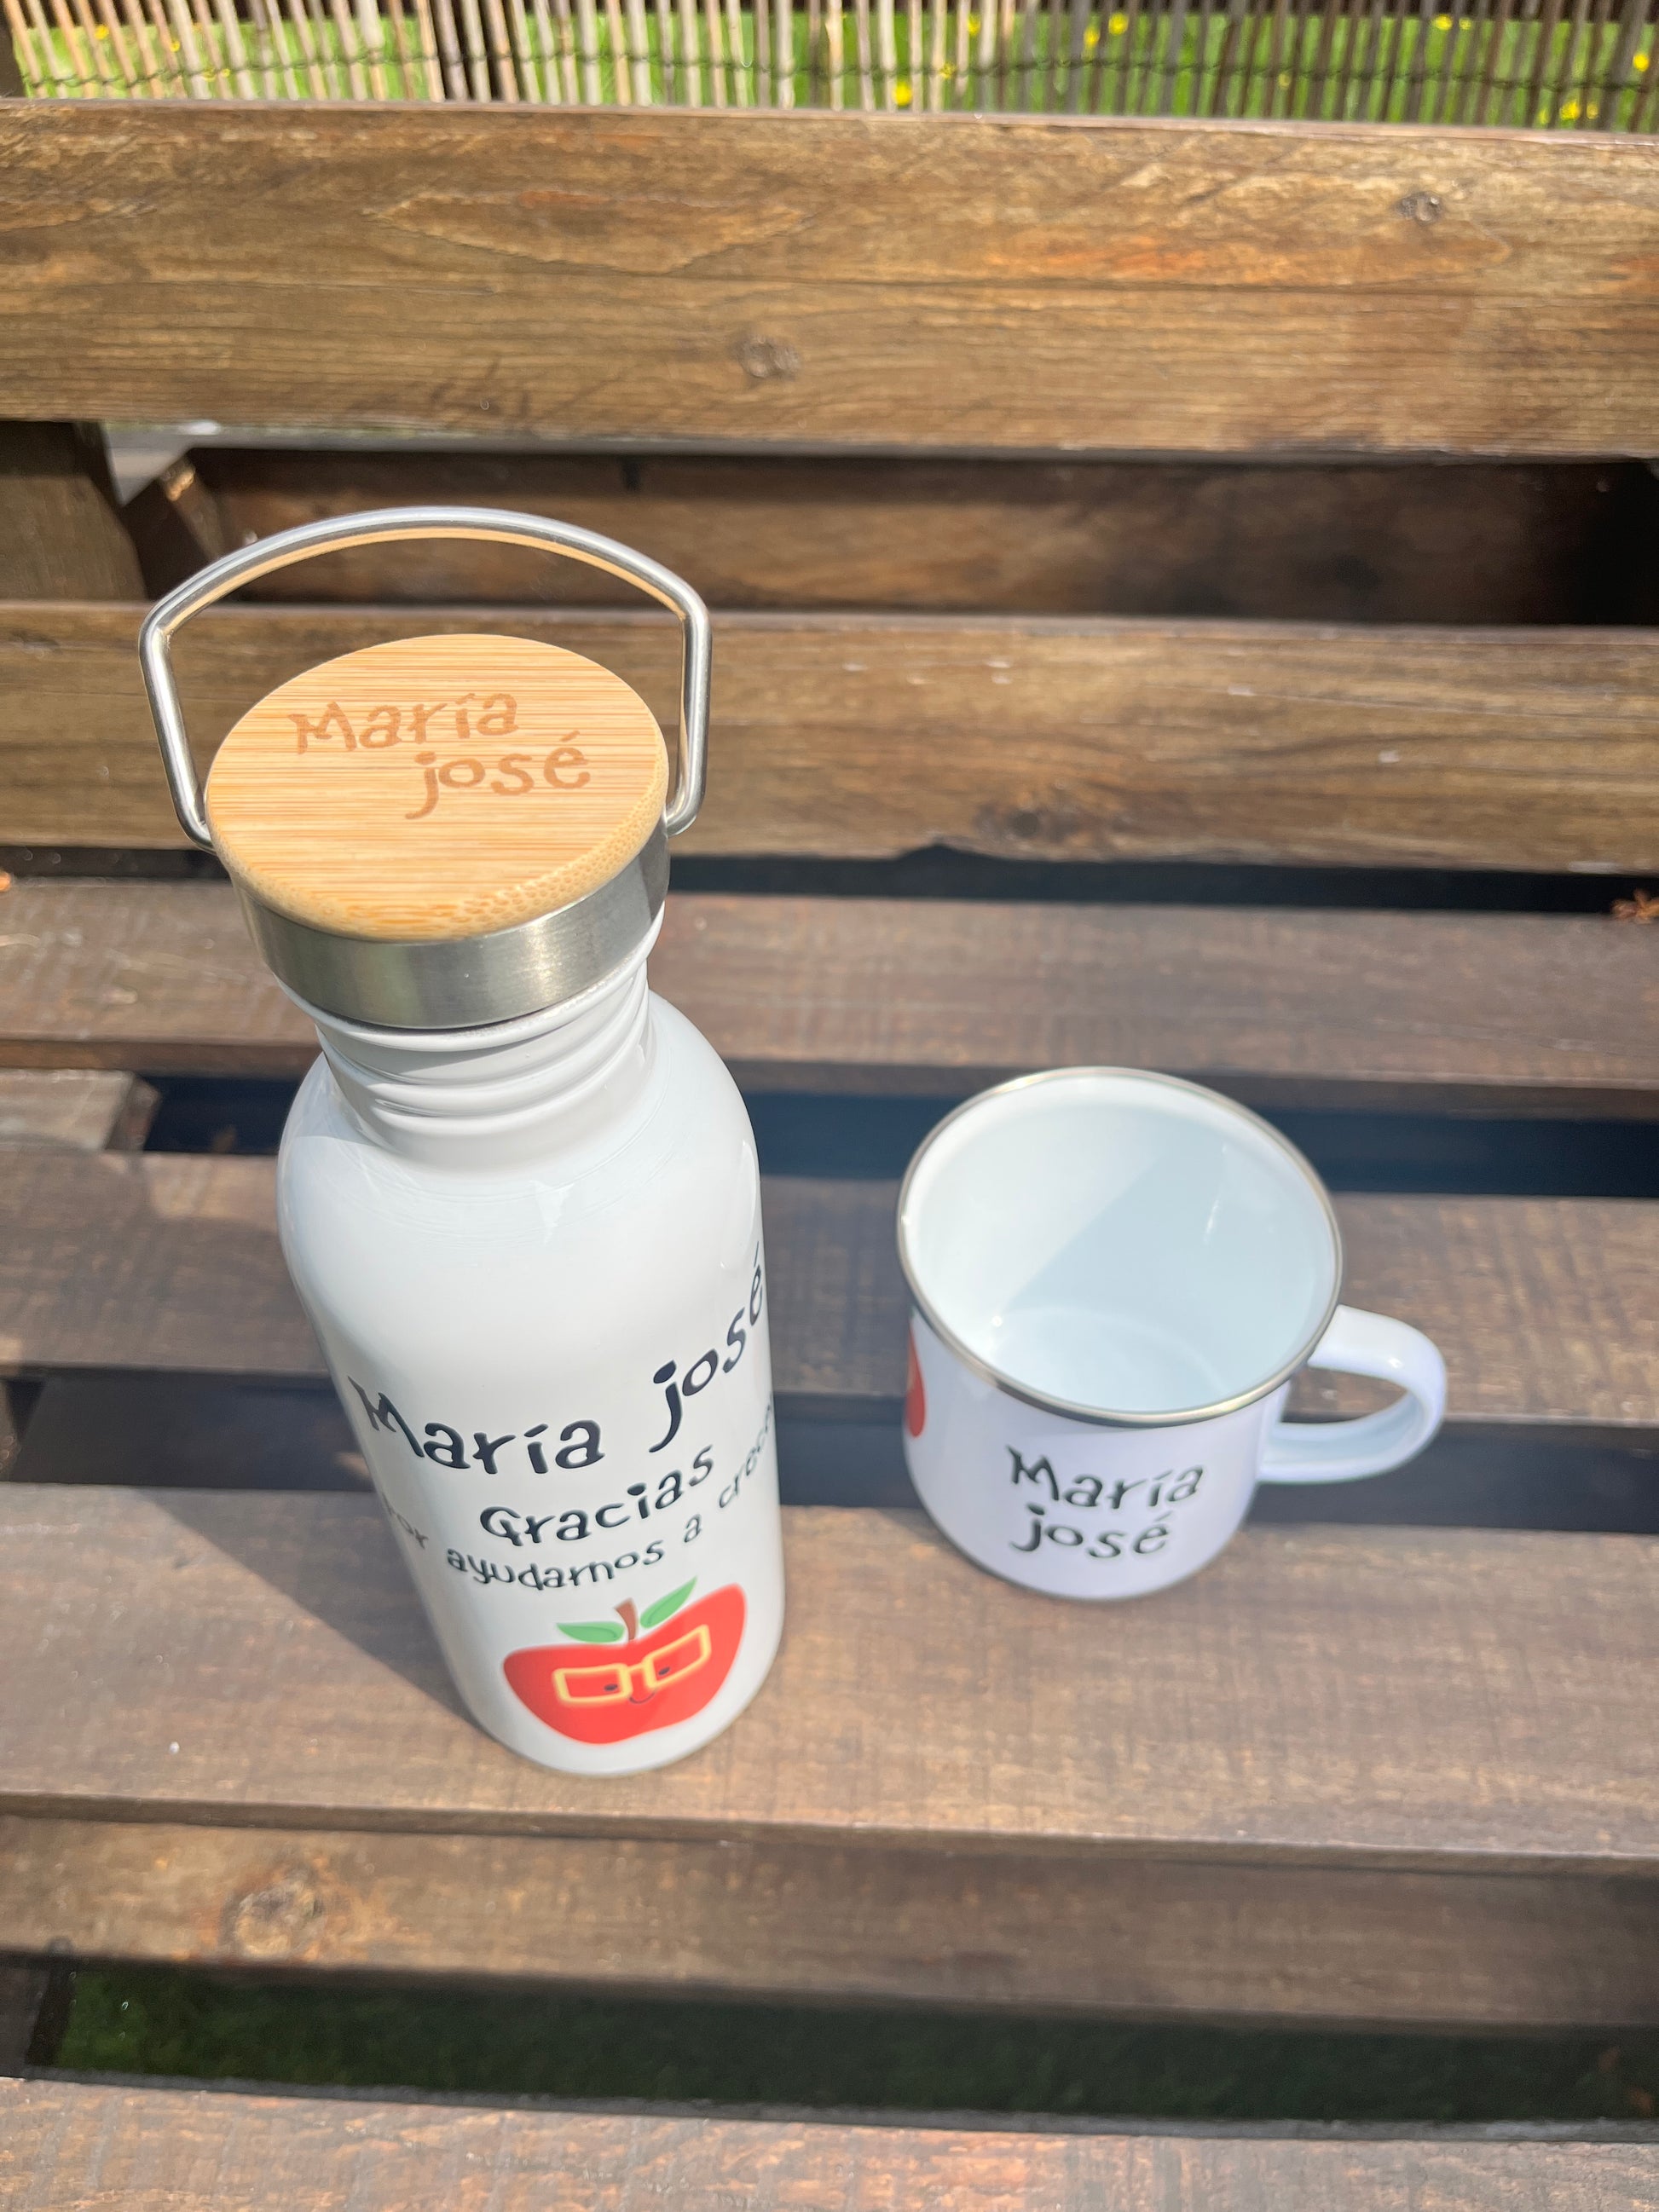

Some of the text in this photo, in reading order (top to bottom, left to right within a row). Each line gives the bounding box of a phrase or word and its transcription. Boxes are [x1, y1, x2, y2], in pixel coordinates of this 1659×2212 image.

[287, 692, 518, 755] María
[404, 731, 591, 820] josé
[347, 1240, 763, 1476] María josé
[479, 1444, 714, 1547] Gracias
[1005, 1443, 1204, 1510] María
[446, 1539, 665, 1591] ayudarnos
[683, 1513, 702, 1544] a
[1008, 1502, 1171, 1558] josé
